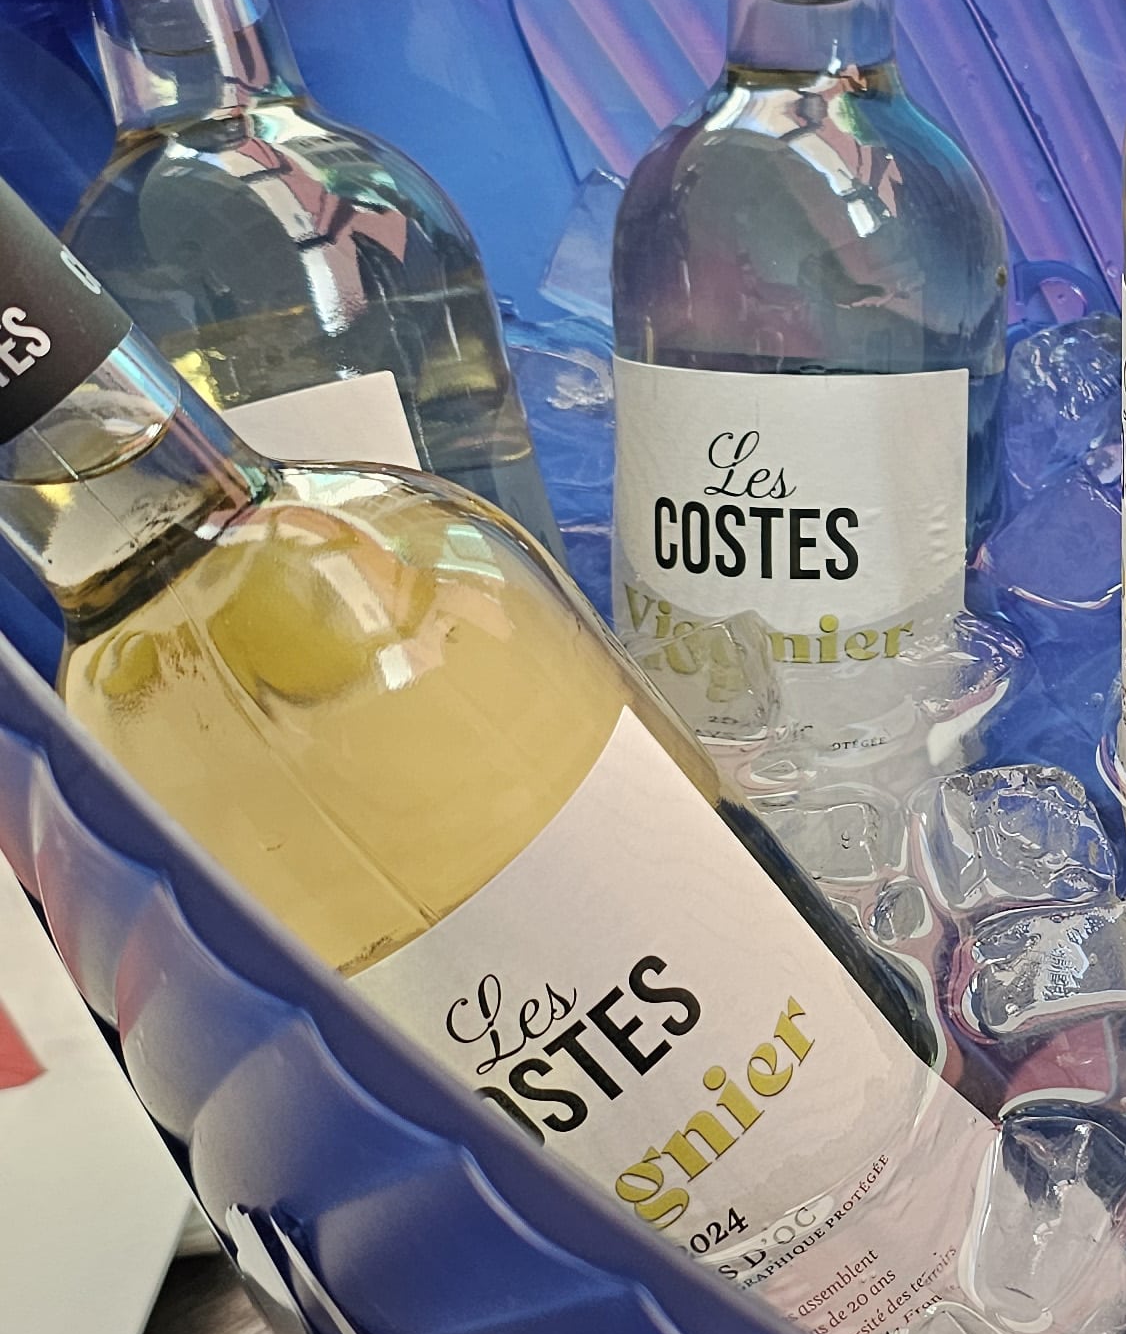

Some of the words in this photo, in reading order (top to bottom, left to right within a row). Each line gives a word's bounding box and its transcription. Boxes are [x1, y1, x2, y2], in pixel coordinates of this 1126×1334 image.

[703, 430, 797, 499] Les
[654, 496, 859, 581] COSTES
[446, 974, 577, 1075] Les
[742, 1227, 826, 1291] RAPHIQUE
[826, 1153, 890, 1229] PROTÉGÉE
[797, 1248, 879, 1318] assemblent
[828, 1309, 847, 1329] de
[847, 1292, 868, 1315] 20
[871, 1268, 897, 1296] ans
[887, 1288, 912, 1314] des
